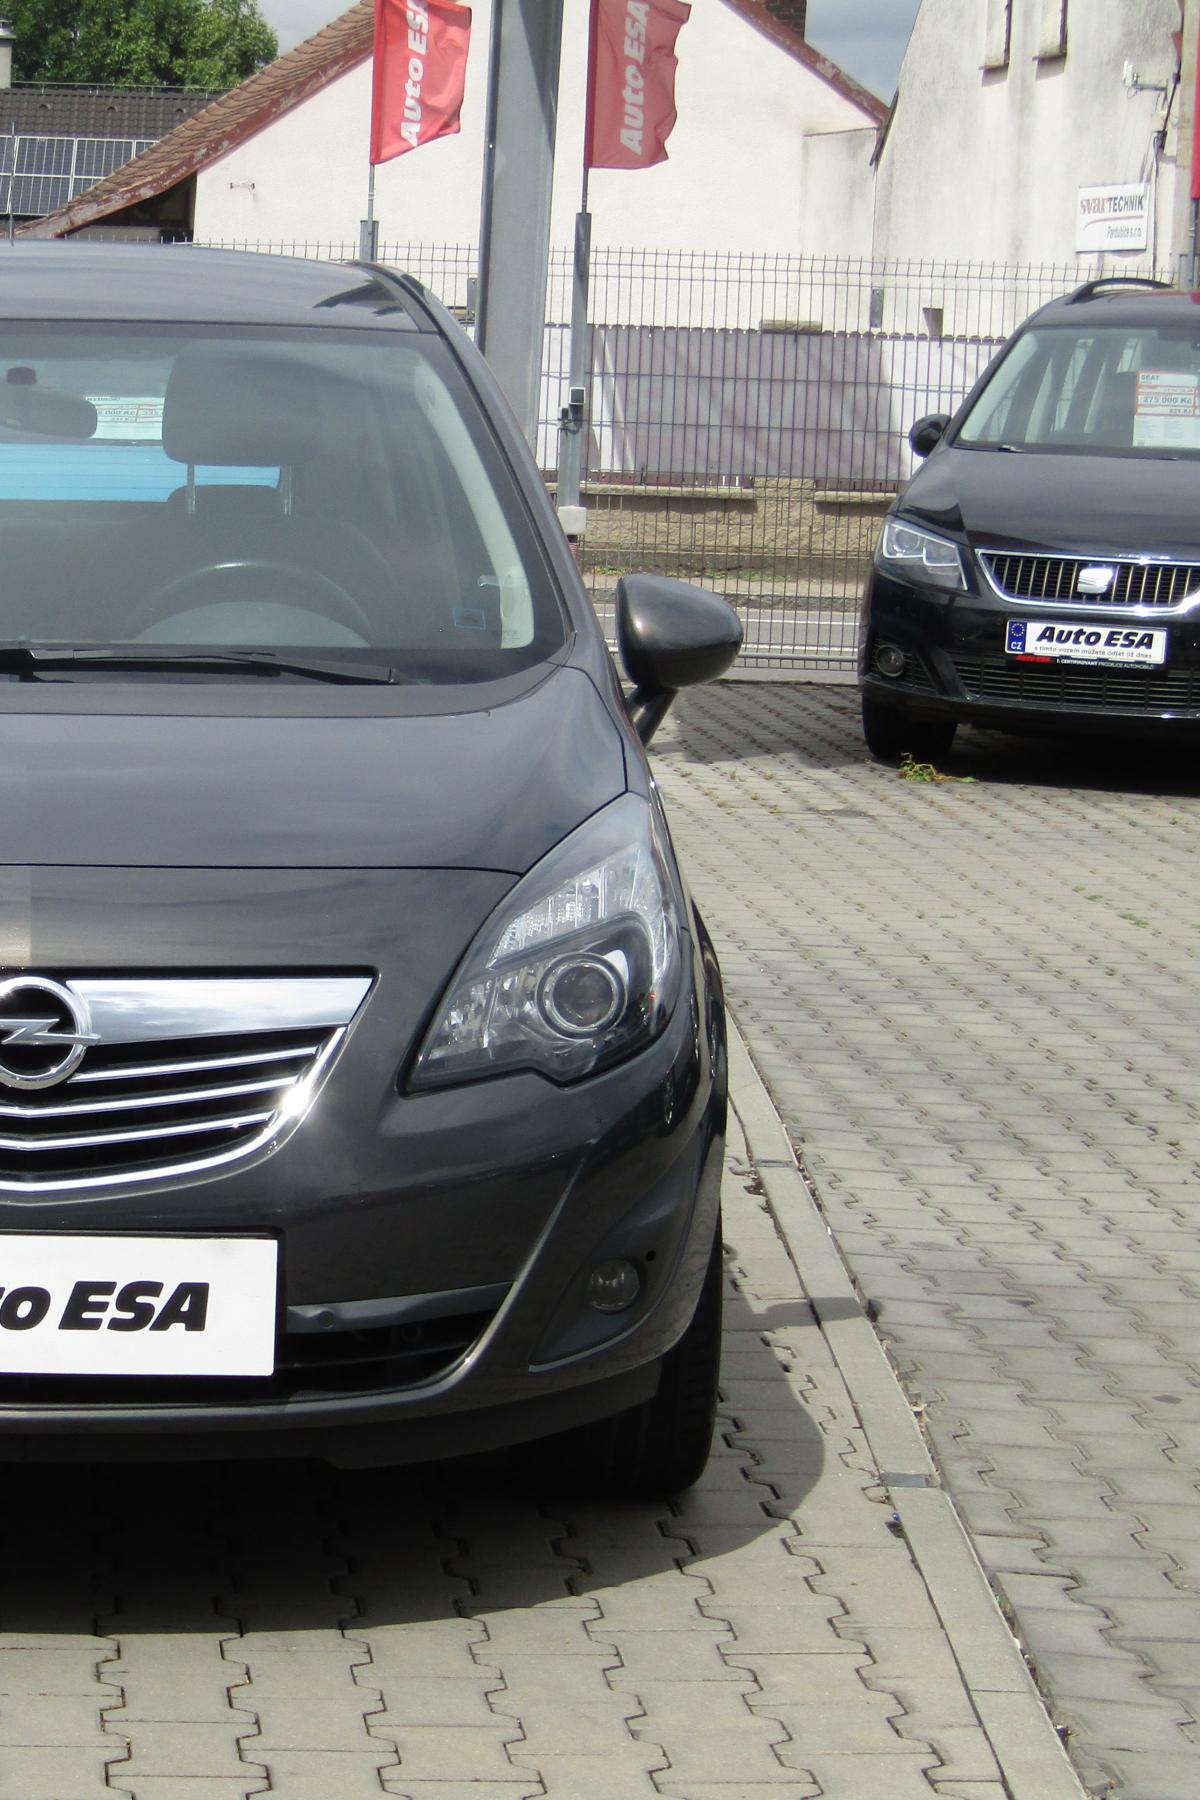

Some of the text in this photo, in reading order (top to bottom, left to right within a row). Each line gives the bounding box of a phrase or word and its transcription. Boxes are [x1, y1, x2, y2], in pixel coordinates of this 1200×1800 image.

[401, 58, 424, 147] Auto
[620, 1, 650, 156] Auto ESA
[1010, 641, 1022, 650] CZ
[1036, 626, 1154, 650] Auto ESA
[58, 1280, 210, 1332] ESA
